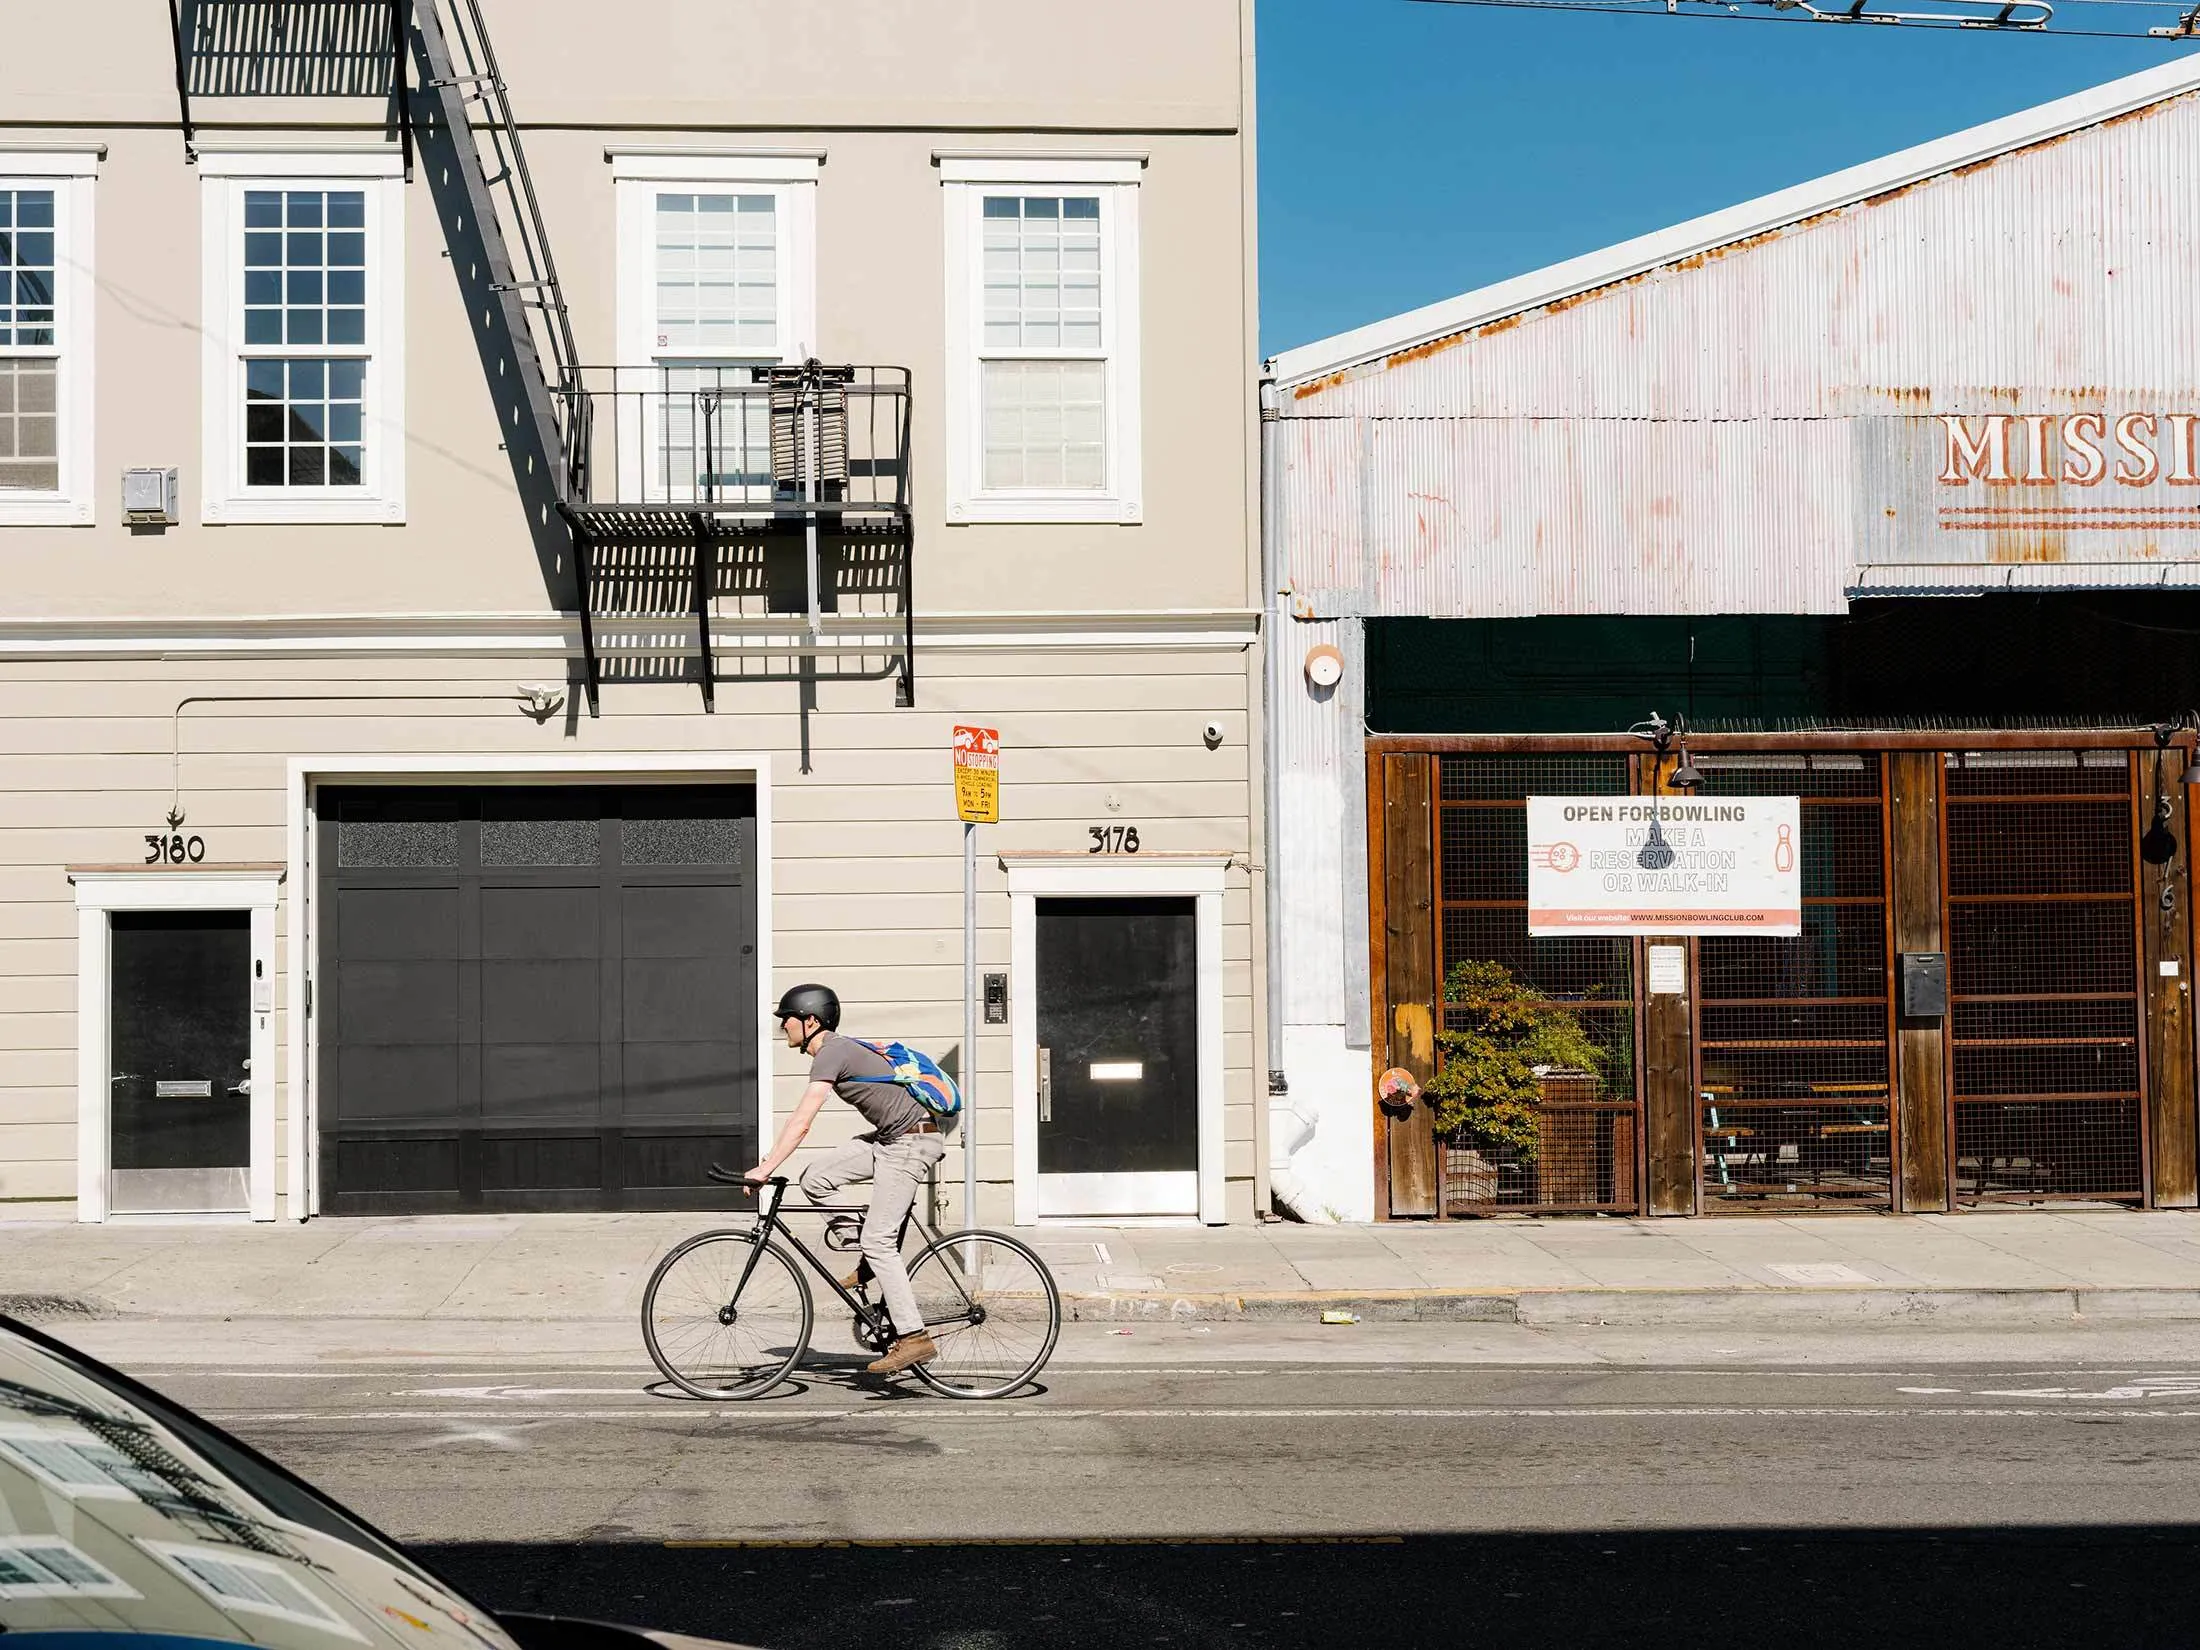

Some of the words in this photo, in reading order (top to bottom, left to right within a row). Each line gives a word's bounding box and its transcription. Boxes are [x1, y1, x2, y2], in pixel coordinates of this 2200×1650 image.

[1937, 412, 2200, 487] MISSI
[955, 748, 967, 767] NO
[968, 753, 998, 769] STOPPING
[963, 799, 975, 808] MON
[981, 800, 991, 809] FRI
[1563, 806, 1613, 822] OPEN
[1619, 806, 1658, 822] FOR
[1660, 806, 1745, 822] BOWLING
[1088, 825, 1140, 854] 3178
[1625, 828, 1686, 847] MAKE
[1690, 828, 1706, 847] A
[144, 834, 206, 864] 3180
[1590, 850, 1736, 870] RESERVATION
[1603, 873, 1632, 892] OR
[1637, 873, 1728, 892] WALK-IN
[1565, 913, 1583, 921] Visit
